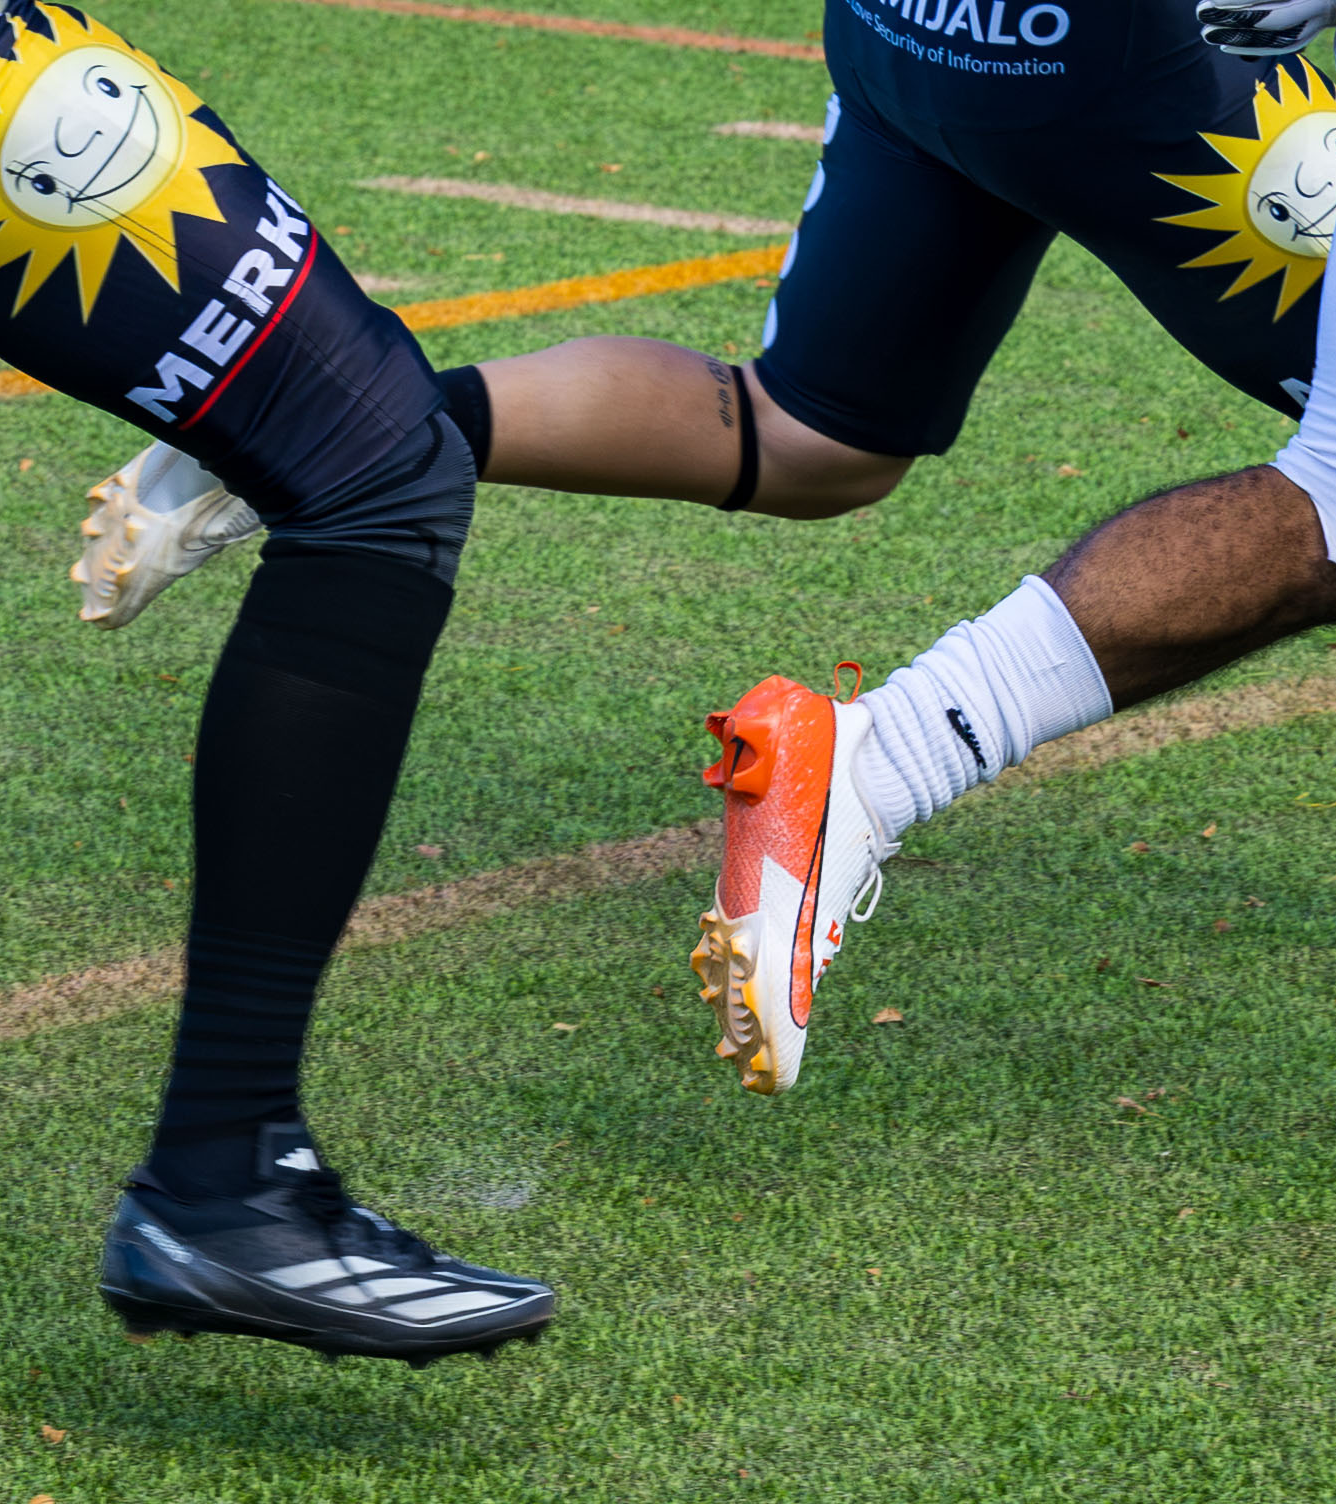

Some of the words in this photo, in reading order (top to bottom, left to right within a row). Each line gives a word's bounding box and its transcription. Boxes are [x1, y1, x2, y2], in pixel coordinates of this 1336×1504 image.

[874, 13, 925, 61] Security
[927, 47, 945, 64] of
[948, 49, 1065, 76] Information
